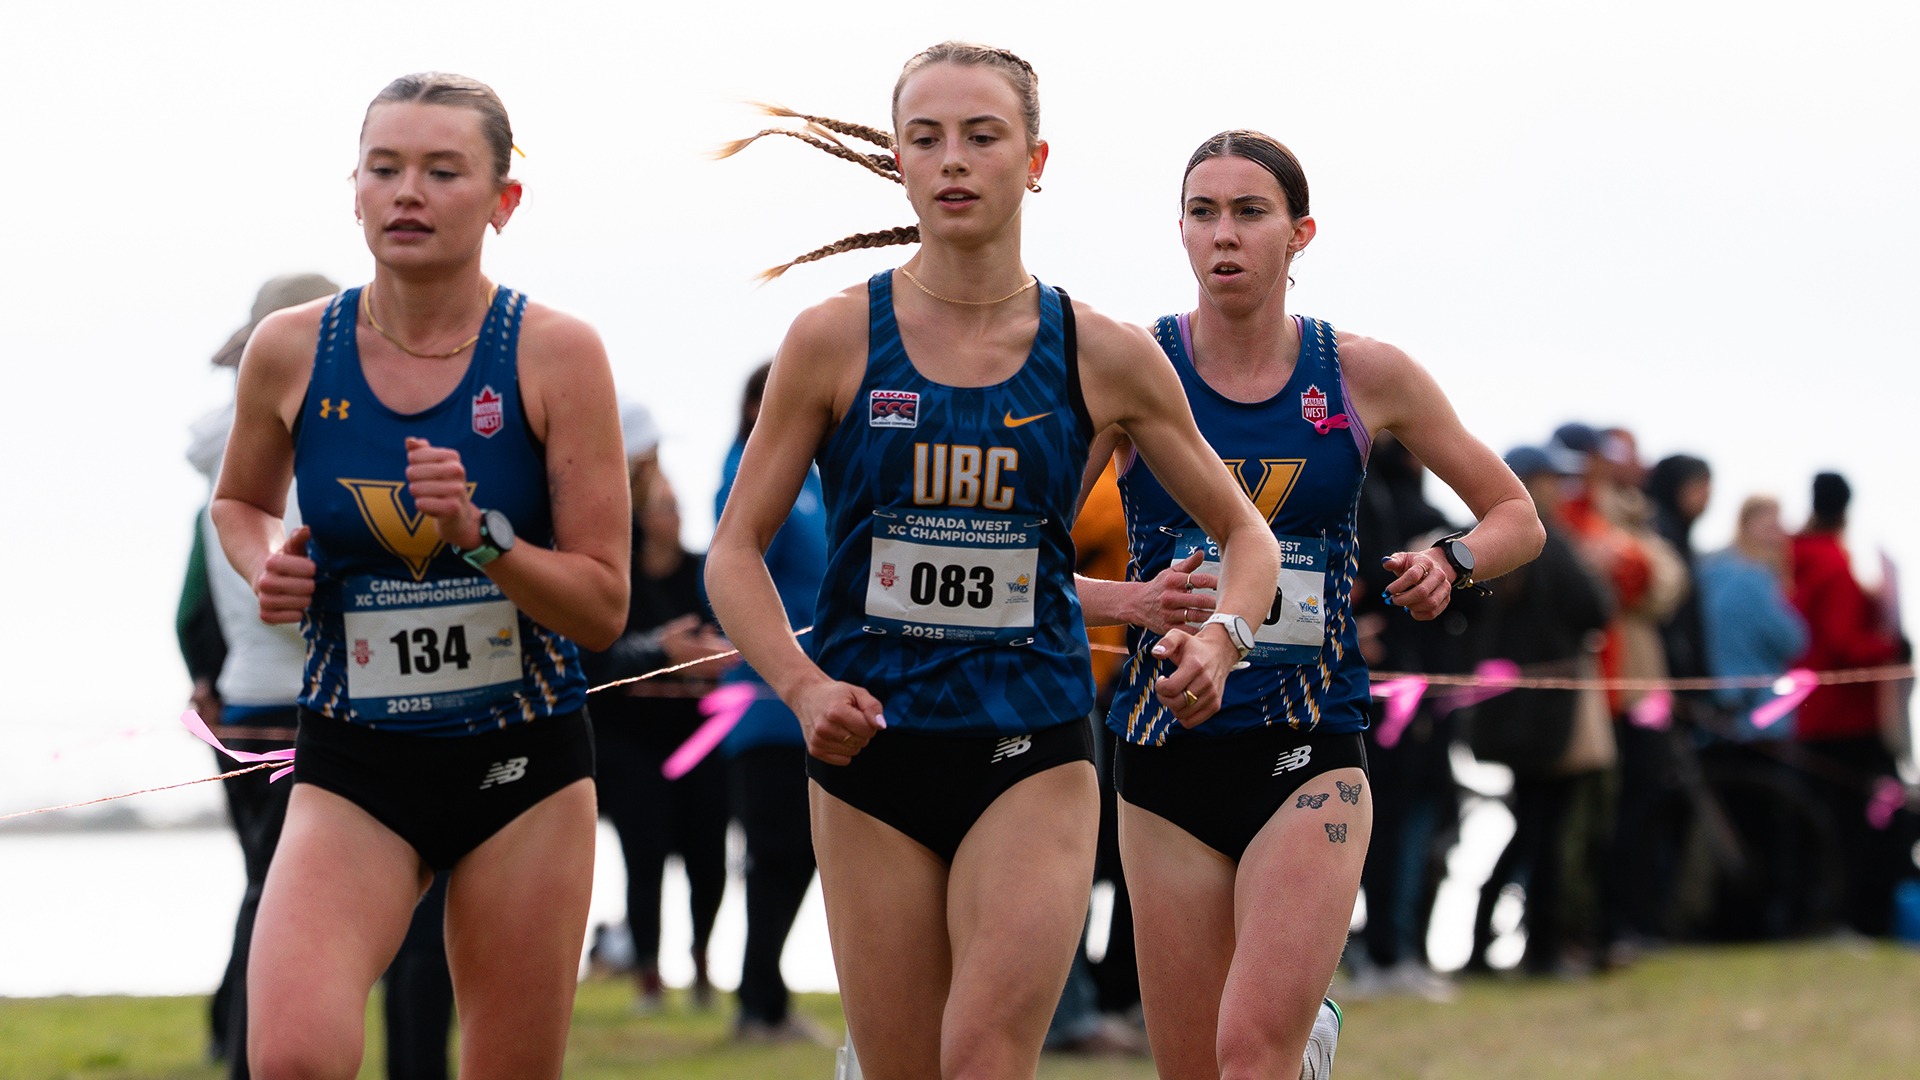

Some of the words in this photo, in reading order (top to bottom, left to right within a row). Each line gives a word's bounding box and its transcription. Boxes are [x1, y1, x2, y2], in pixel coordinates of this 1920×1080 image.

[872, 391, 918, 400] CASCADE
[1303, 398, 1325, 406] CANADA
[872, 401, 916, 417] CCC
[1304, 407, 1326, 418] WEST
[913, 442, 1019, 511] UBC
[905, 514, 967, 530] CANADA
[970, 519, 1012, 532] WEST
[887, 524, 907, 536] XC
[910, 526, 1028, 544] CHAMPIONSHIPS
[1279, 540, 1301, 552] EST
[910, 561, 995, 609] 083
[355, 594, 374, 607] XC
[376, 584, 501, 606] CHAMPIONSHIPS
[902, 624, 946, 640] 2025
[389, 624, 472, 675] 134
[387, 696, 433, 715] 2025
